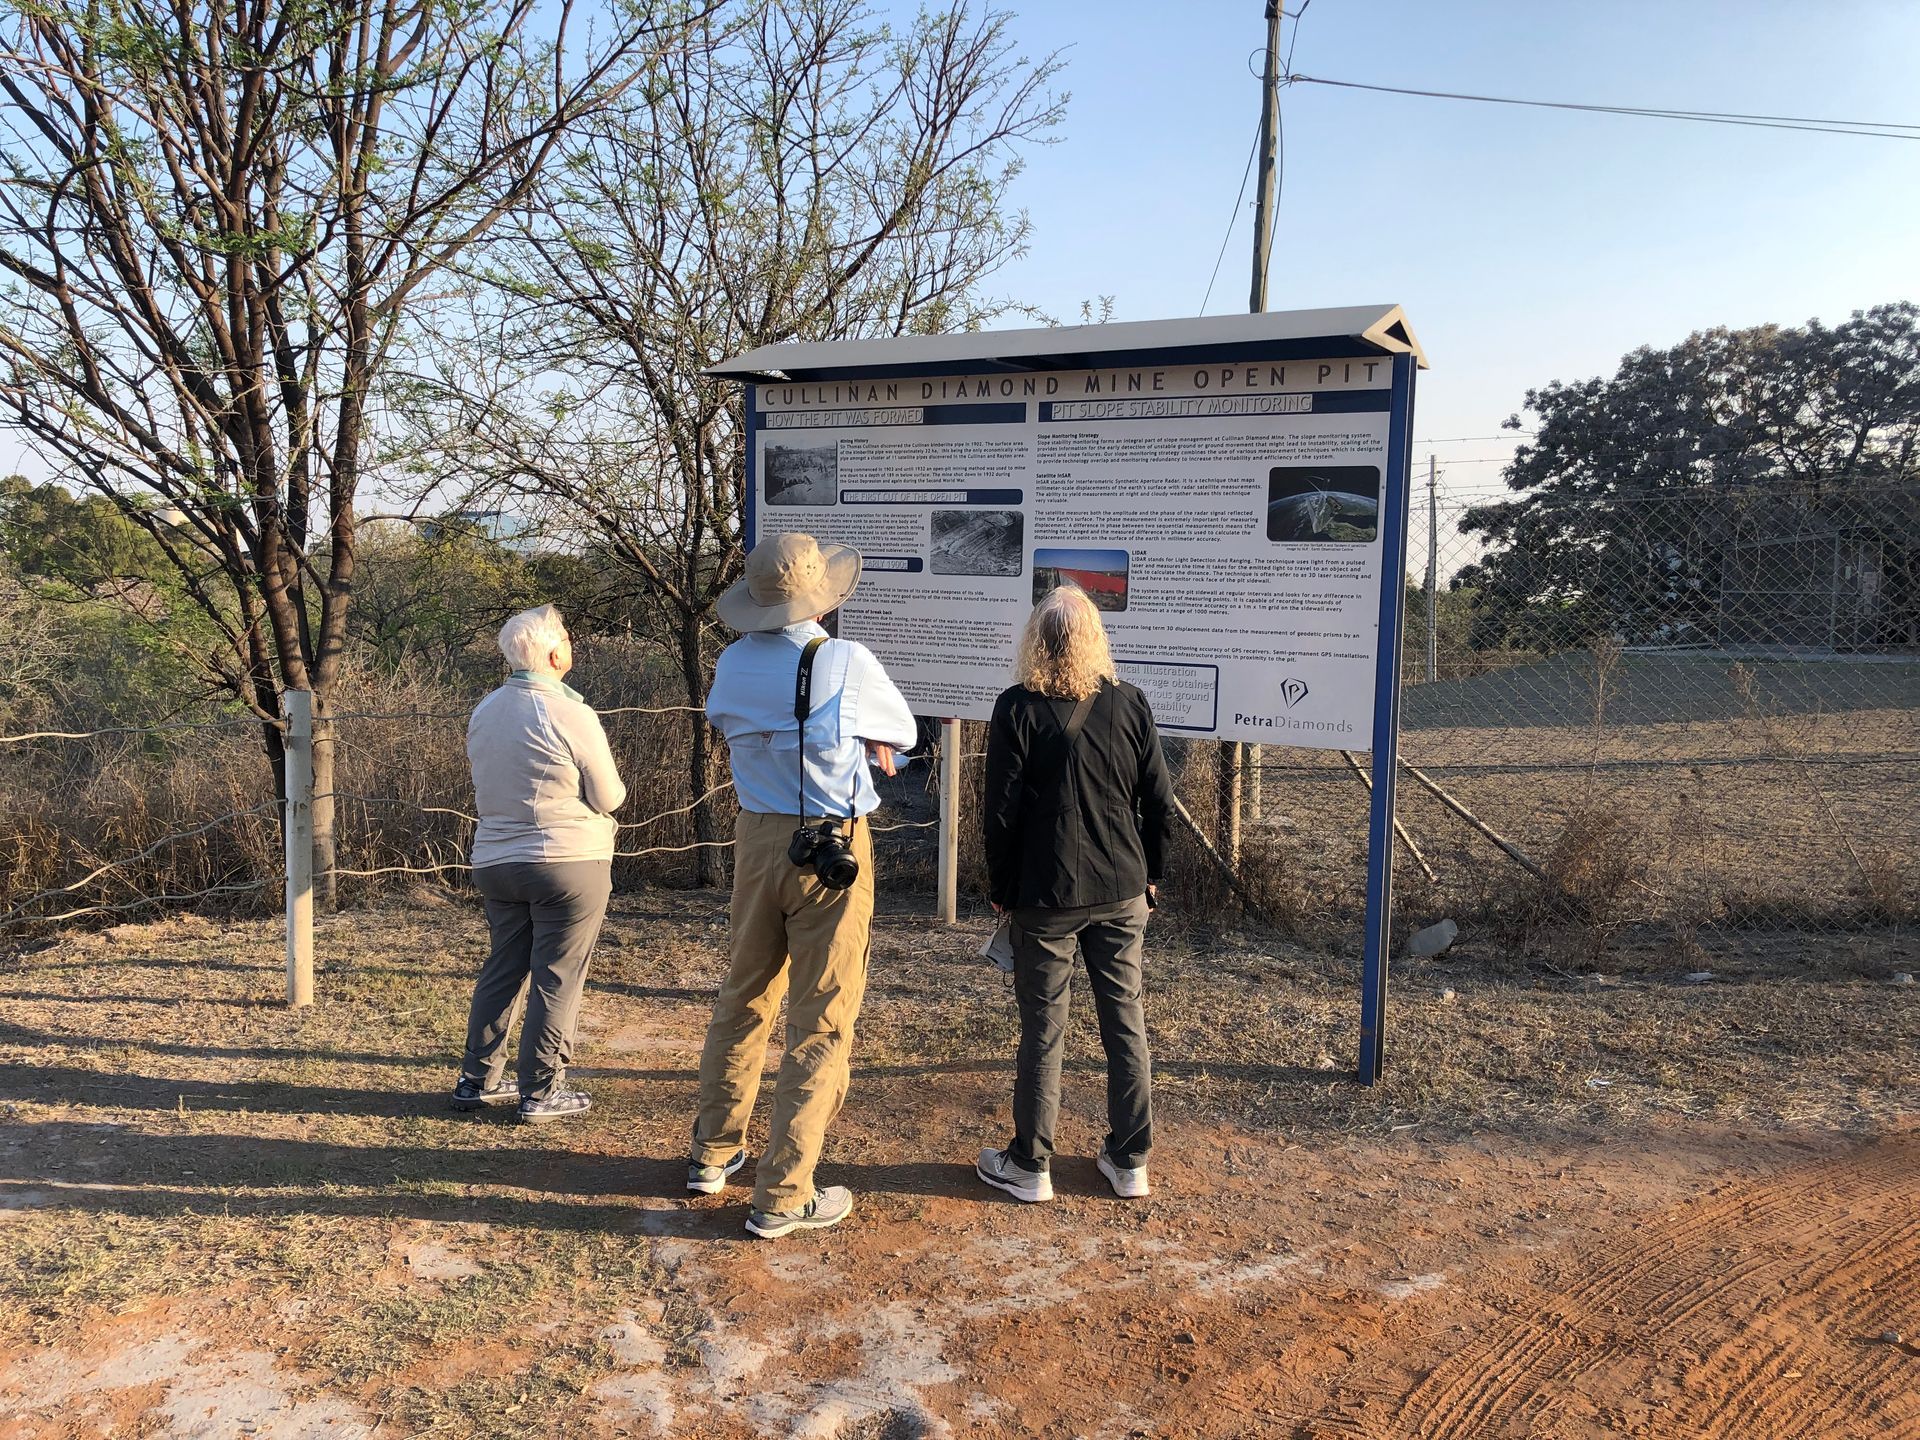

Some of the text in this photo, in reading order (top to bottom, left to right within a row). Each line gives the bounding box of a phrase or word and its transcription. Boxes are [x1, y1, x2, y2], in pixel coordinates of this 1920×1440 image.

[765, 362, 1379, 405] CULLINAN DIAMOND MINE OPEN PIT
[1052, 394, 1312, 419] PIT SLOPE STABILITY MONITORING
[766, 408, 923, 427] HOW THE PIT WAS FORMED
[846, 493, 968, 501] THE FIRST CUT OF THE OPEN PIT
[864, 560, 885, 568] EARLY
[1175, 626, 1210, 634] displacement
[1240, 654, 1266, 662] proximity
[1116, 664, 1197, 678] hical illustration
[1126, 678, 1216, 690] coverage obtained
[1144, 688, 1210, 702] arious ground
[1151, 701, 1192, 714] stability
[1152, 713, 1186, 724] ystems
[1234, 713, 1354, 733] PetraDiamonds
